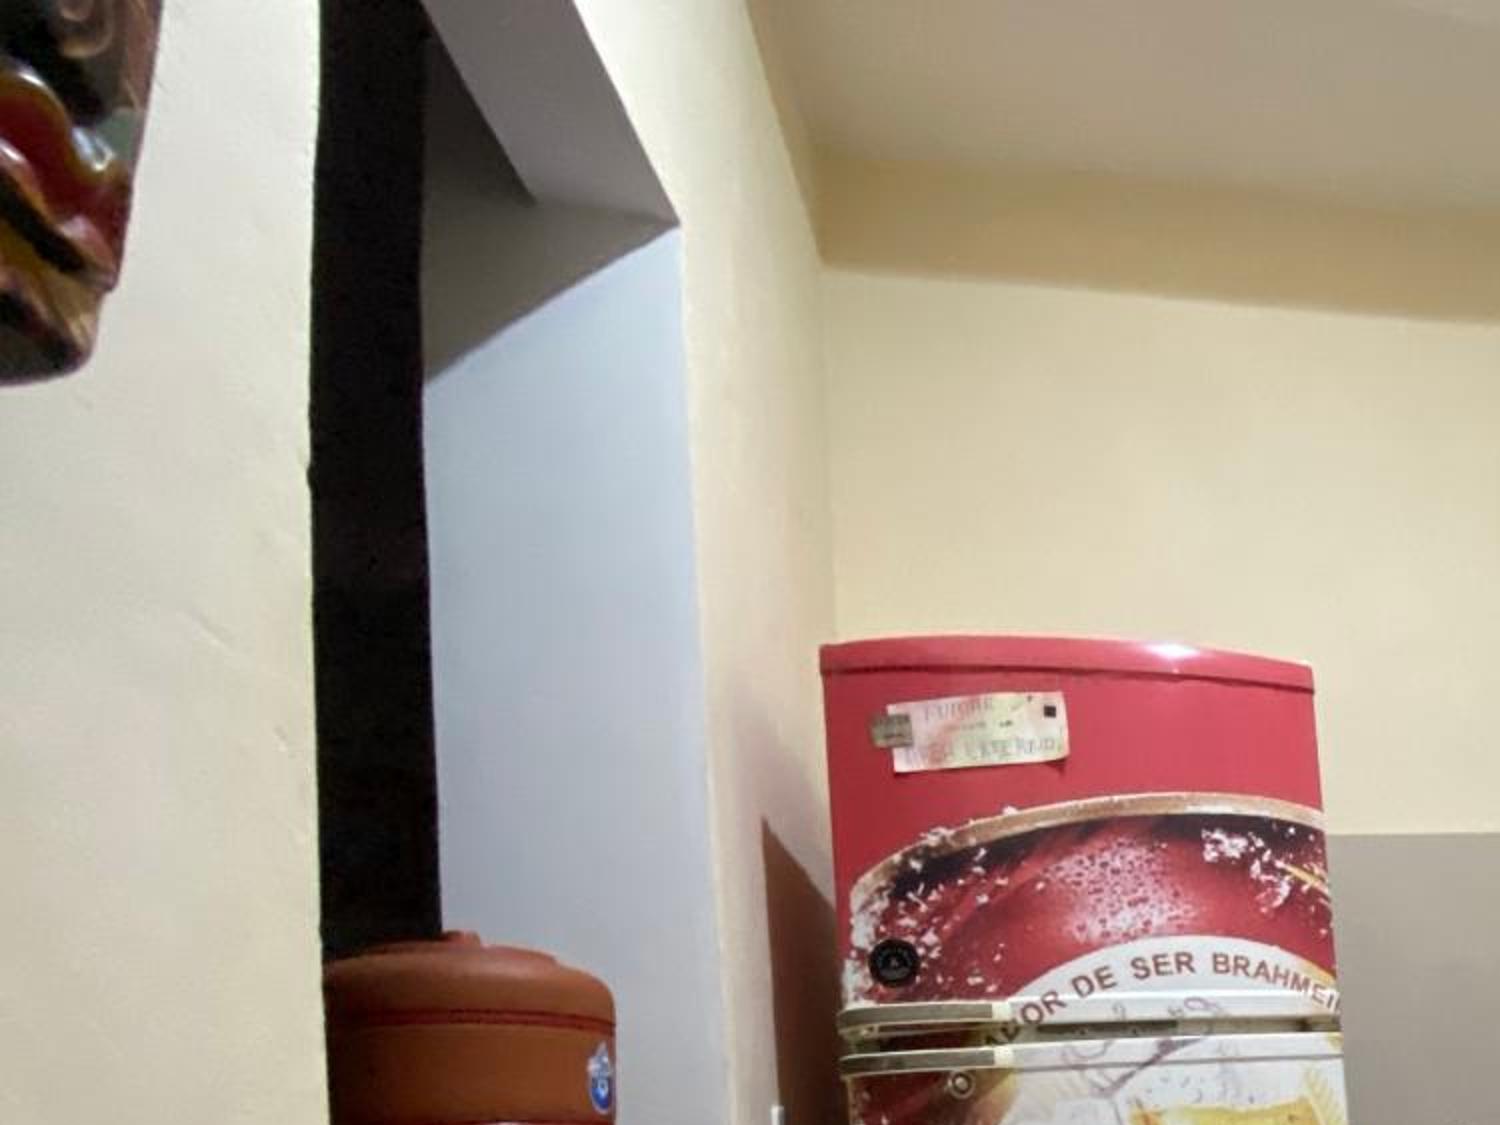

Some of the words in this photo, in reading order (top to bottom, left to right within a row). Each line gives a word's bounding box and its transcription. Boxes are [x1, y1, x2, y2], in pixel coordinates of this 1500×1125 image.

[1071, 964, 1118, 998] DE
[1131, 951, 1196, 980] SER
[1212, 953, 1341, 1010] BRAHMEI
